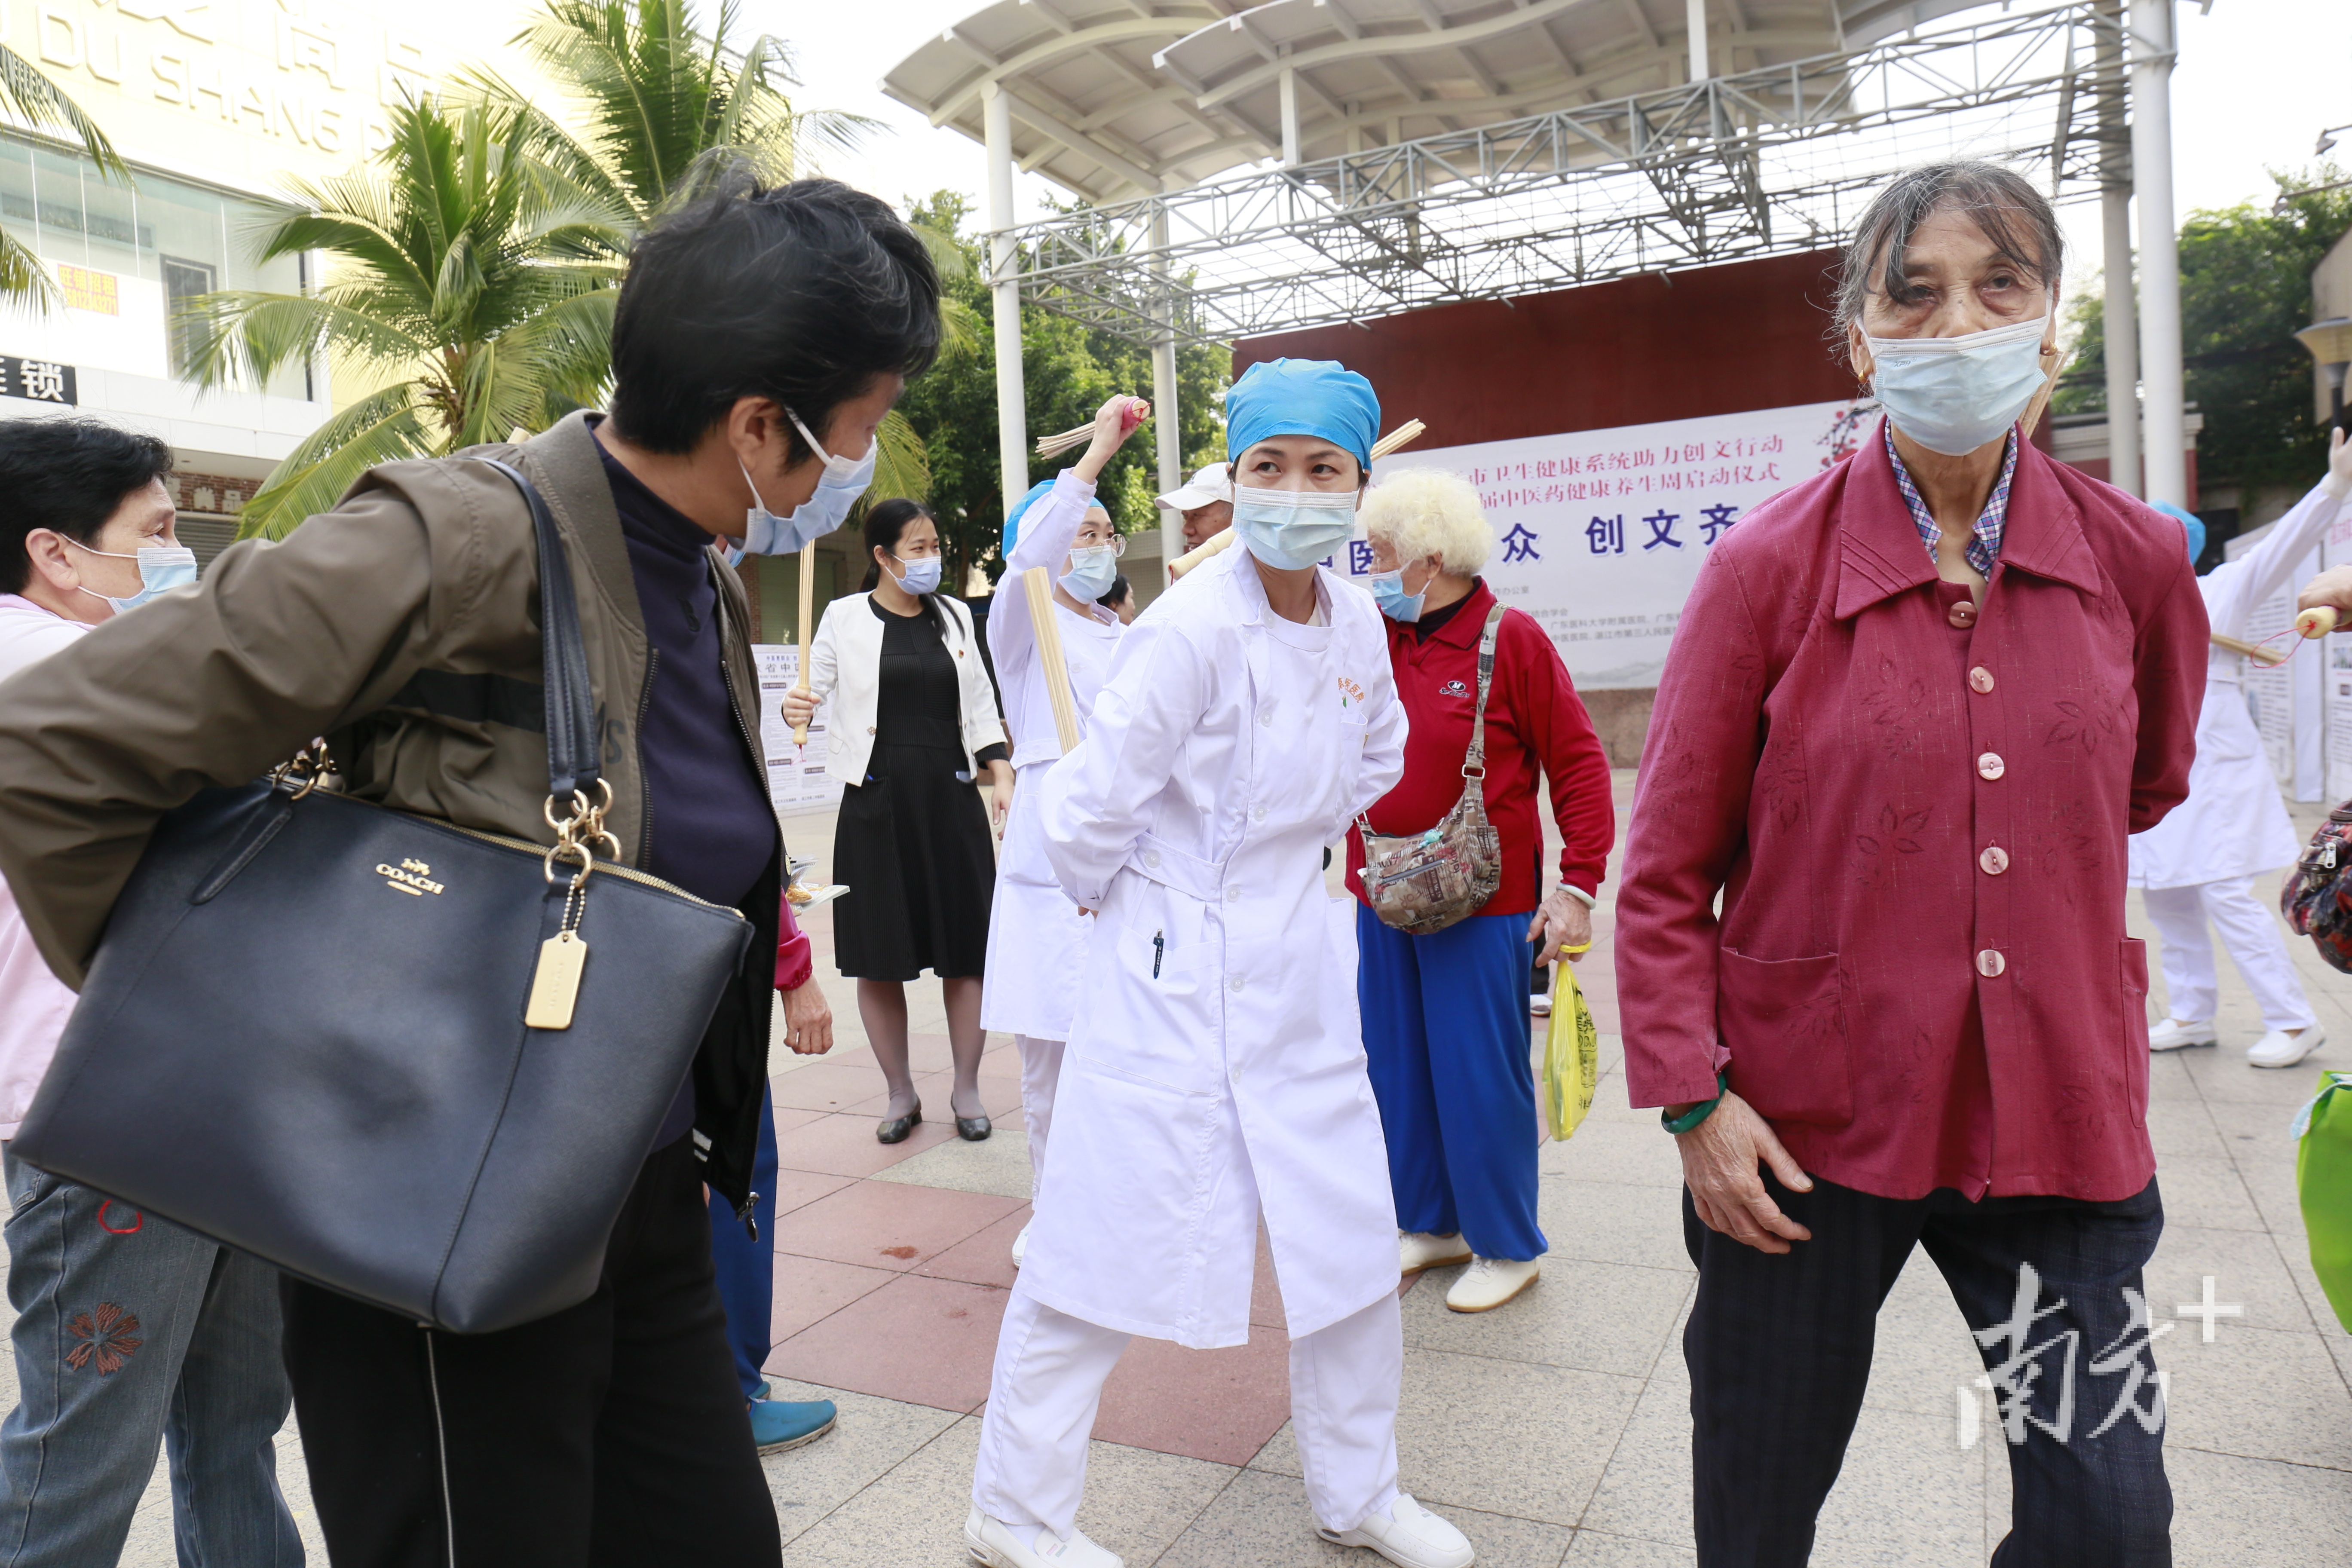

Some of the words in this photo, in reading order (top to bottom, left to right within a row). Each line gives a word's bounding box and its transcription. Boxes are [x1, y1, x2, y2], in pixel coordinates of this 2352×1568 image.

[58, 266, 116, 297] 旺铺招租
[0, 357, 64, 401] 锁
[1456, 434, 1783, 487] 市卫生健康系统助力创文行动
[376, 863, 445, 895] COACH
